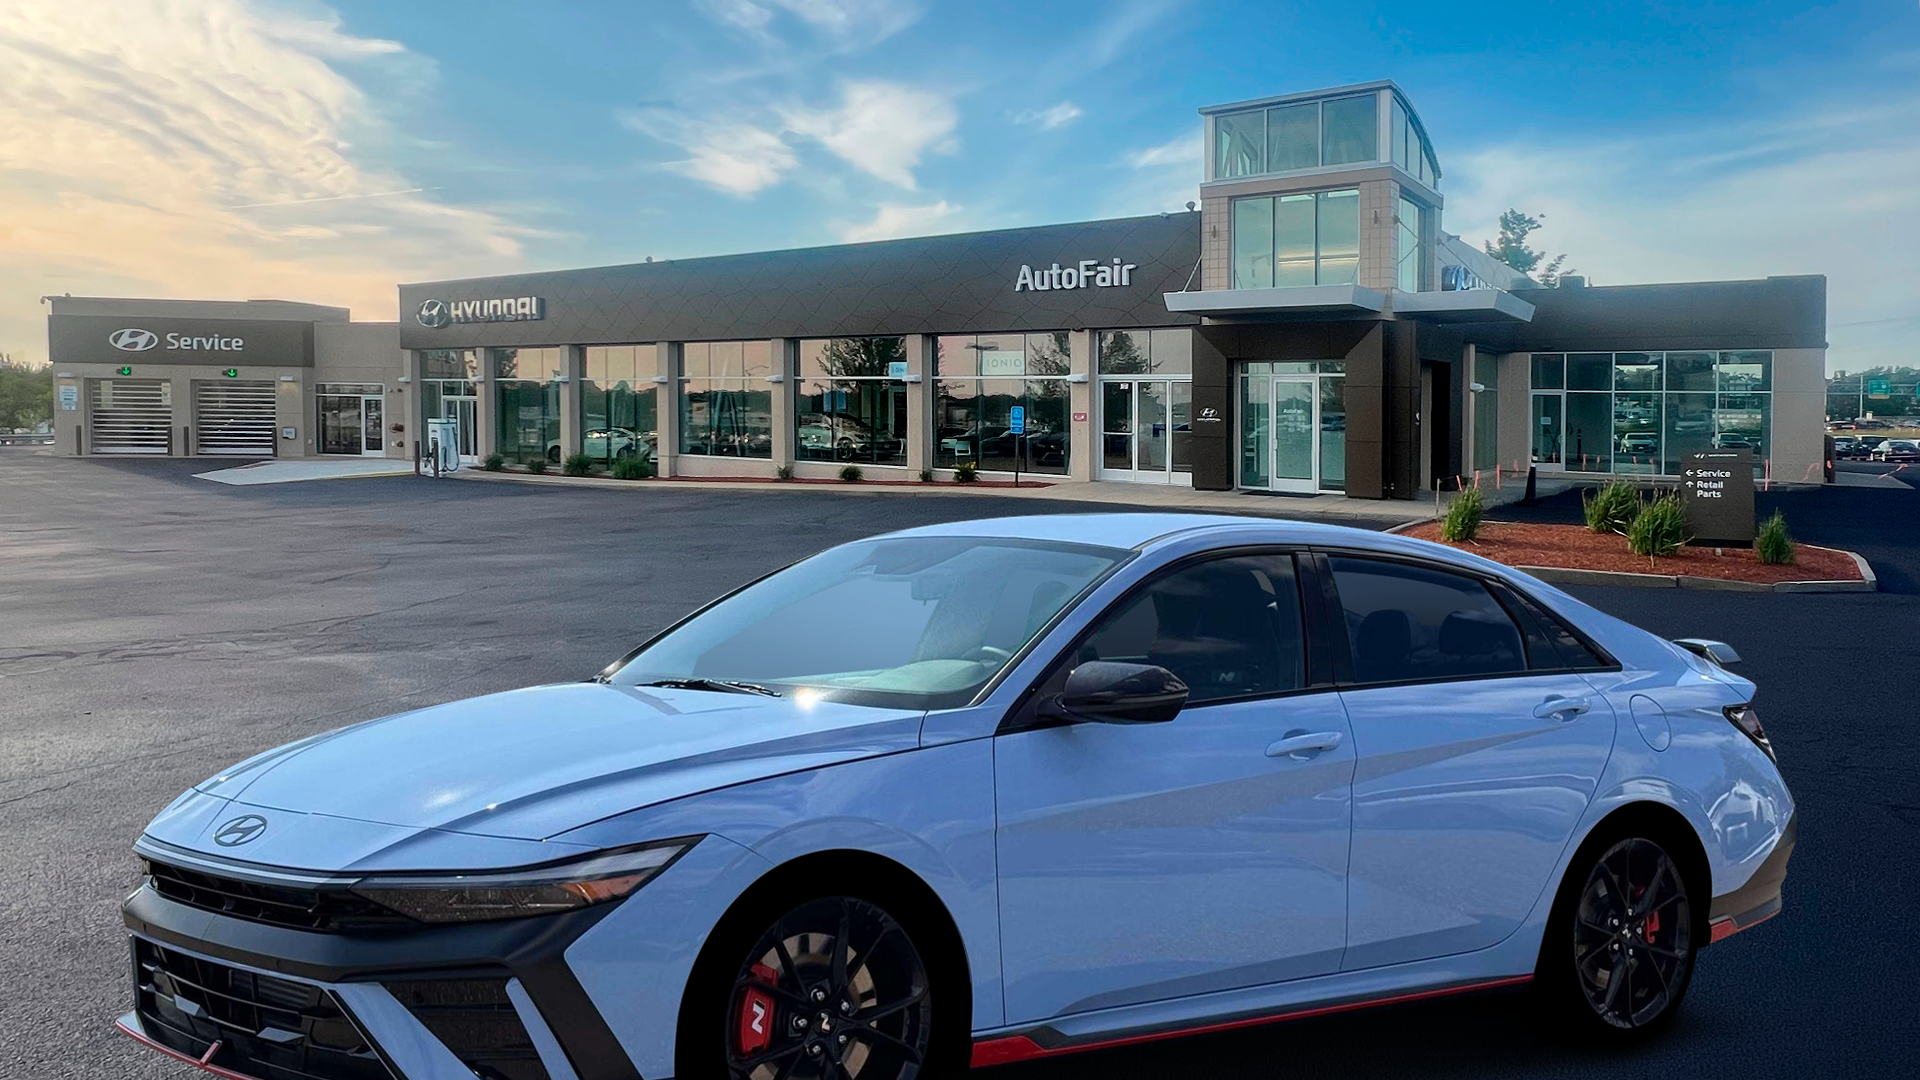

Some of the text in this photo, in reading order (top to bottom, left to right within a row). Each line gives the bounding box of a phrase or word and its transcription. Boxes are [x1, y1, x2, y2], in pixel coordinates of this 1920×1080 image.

[1015, 258, 1137, 292] AutoFair
[450, 297, 537, 321] HYUNDAI
[166, 332, 244, 351] Service
[1696, 469, 1731, 478] Service
[1696, 480, 1724, 489] Retail
[1696, 489, 1722, 498] Parts
